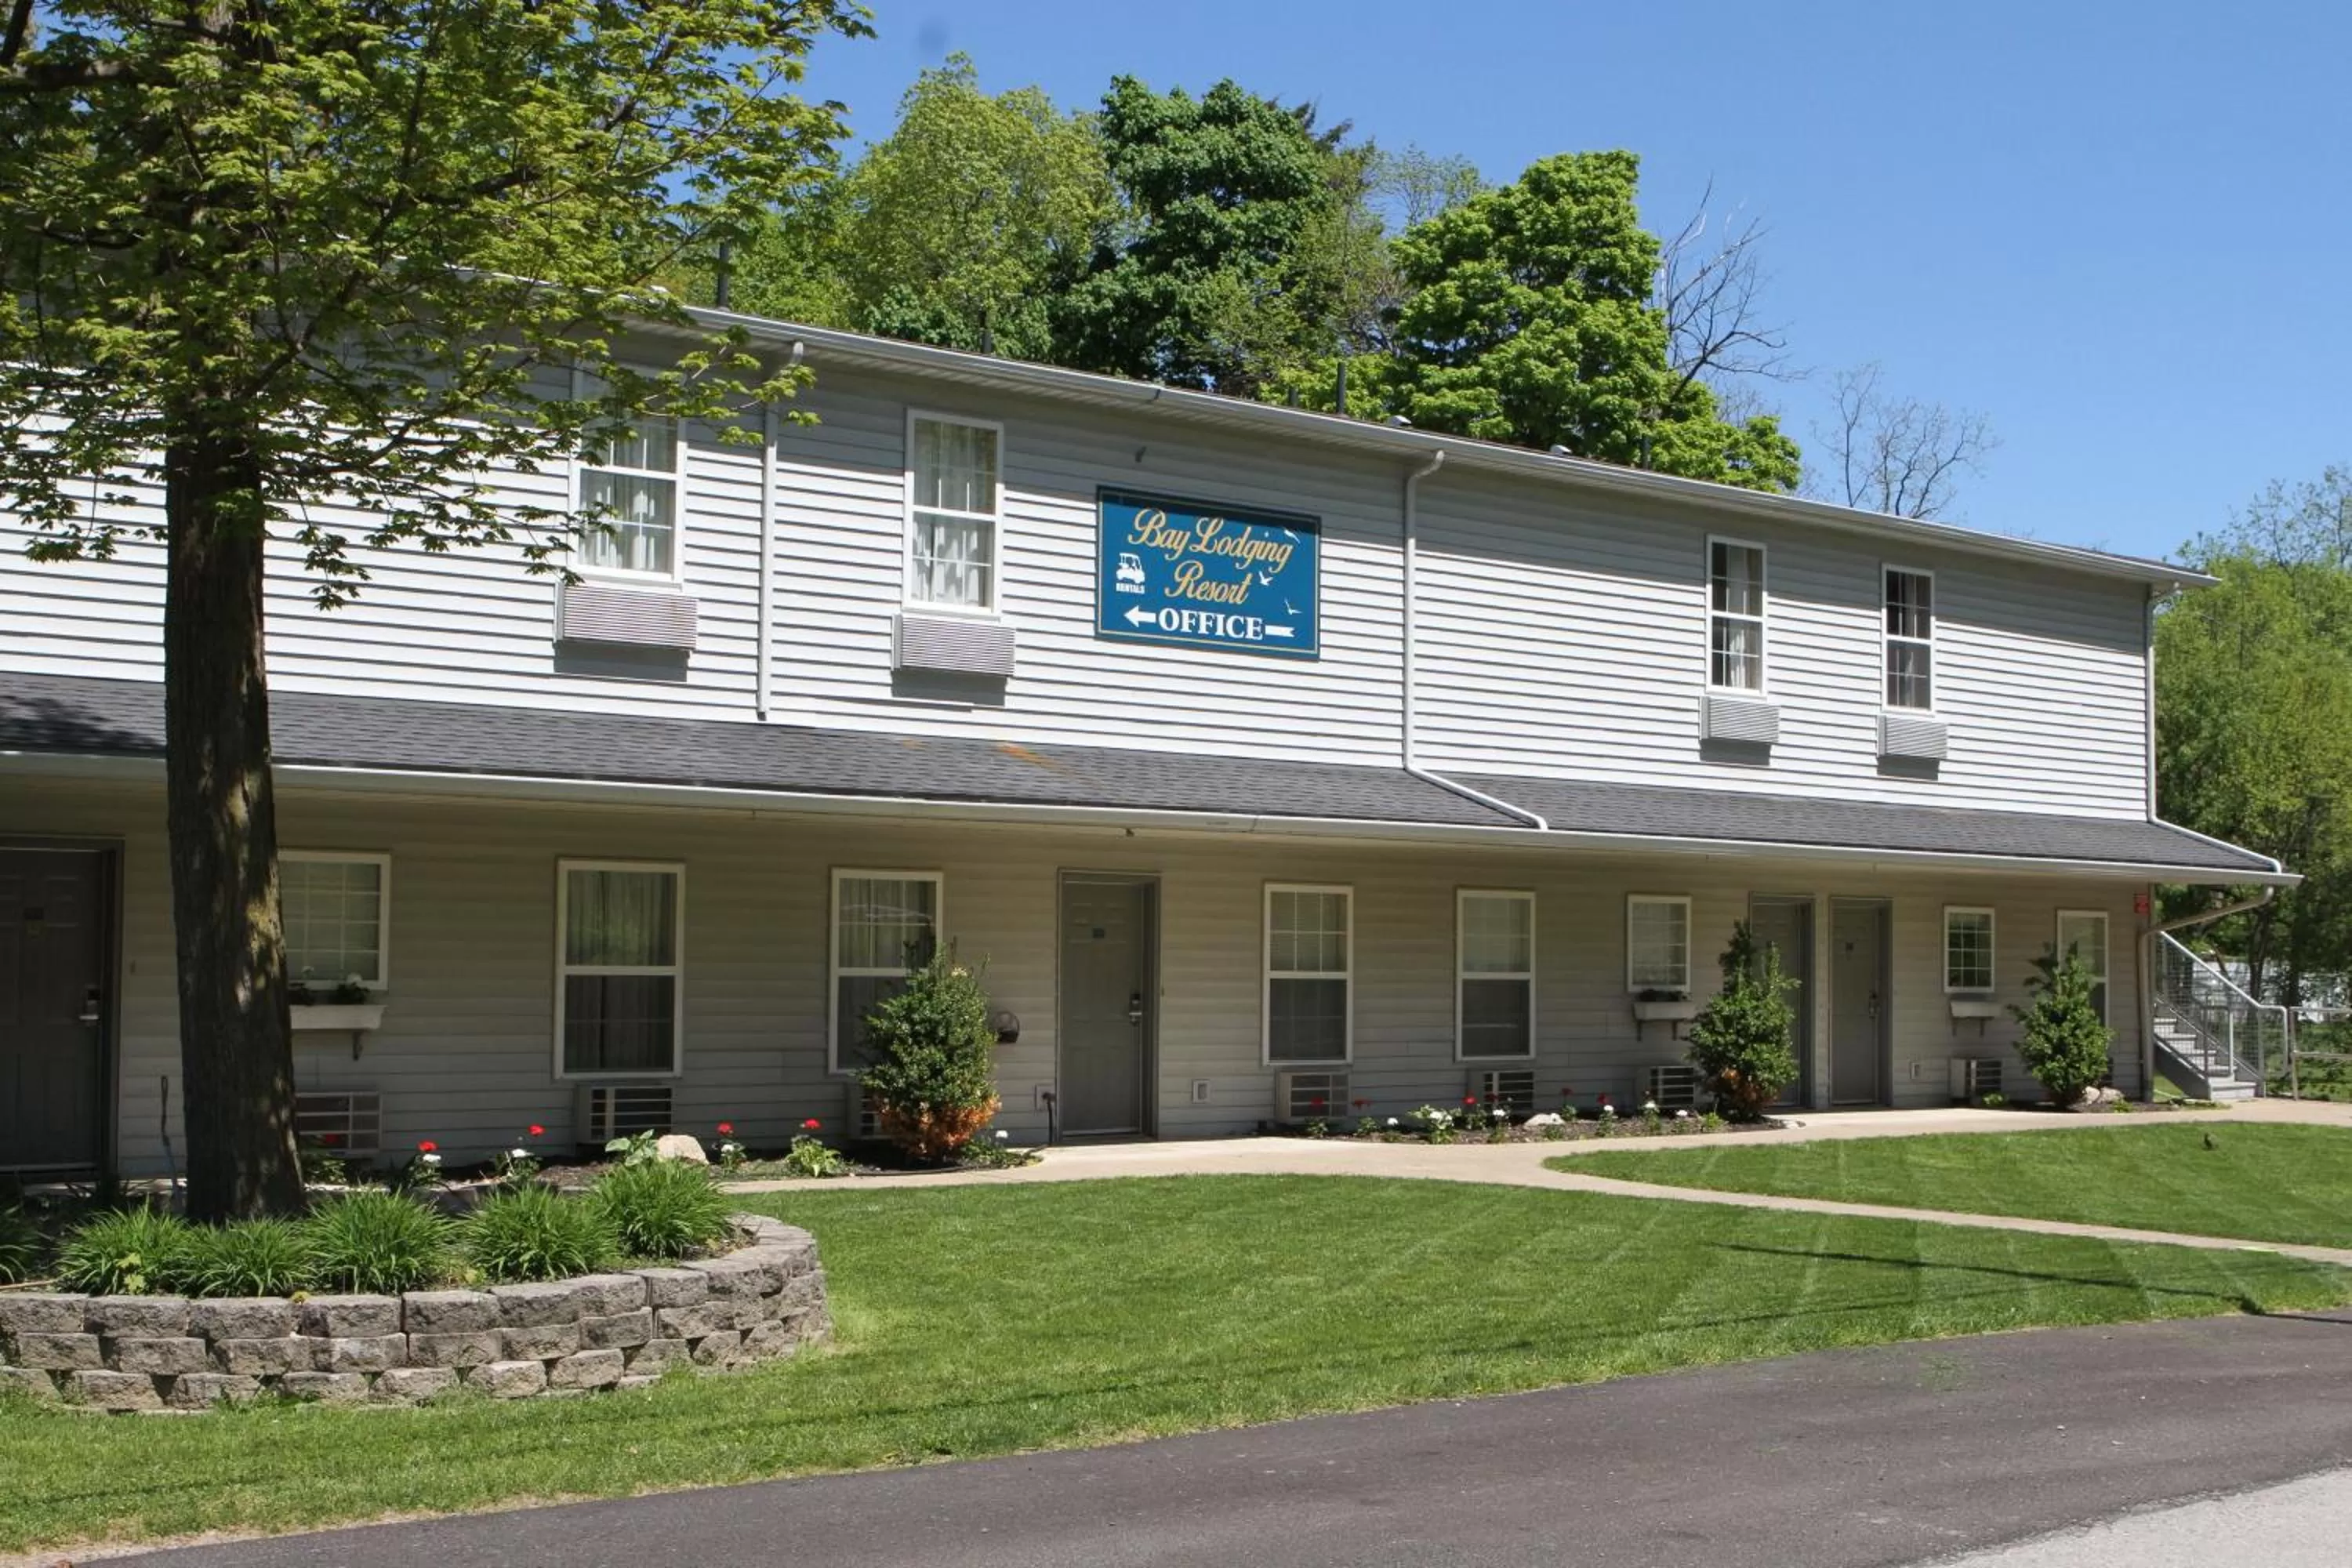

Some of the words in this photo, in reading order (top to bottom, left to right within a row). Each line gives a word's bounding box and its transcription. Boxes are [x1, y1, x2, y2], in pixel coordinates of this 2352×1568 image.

[1127, 507, 1191, 561] Bay
[1189, 517, 1293, 573] Lodging
[1164, 560, 1253, 604] Resort
[1159, 608, 1263, 641] OFFICE
